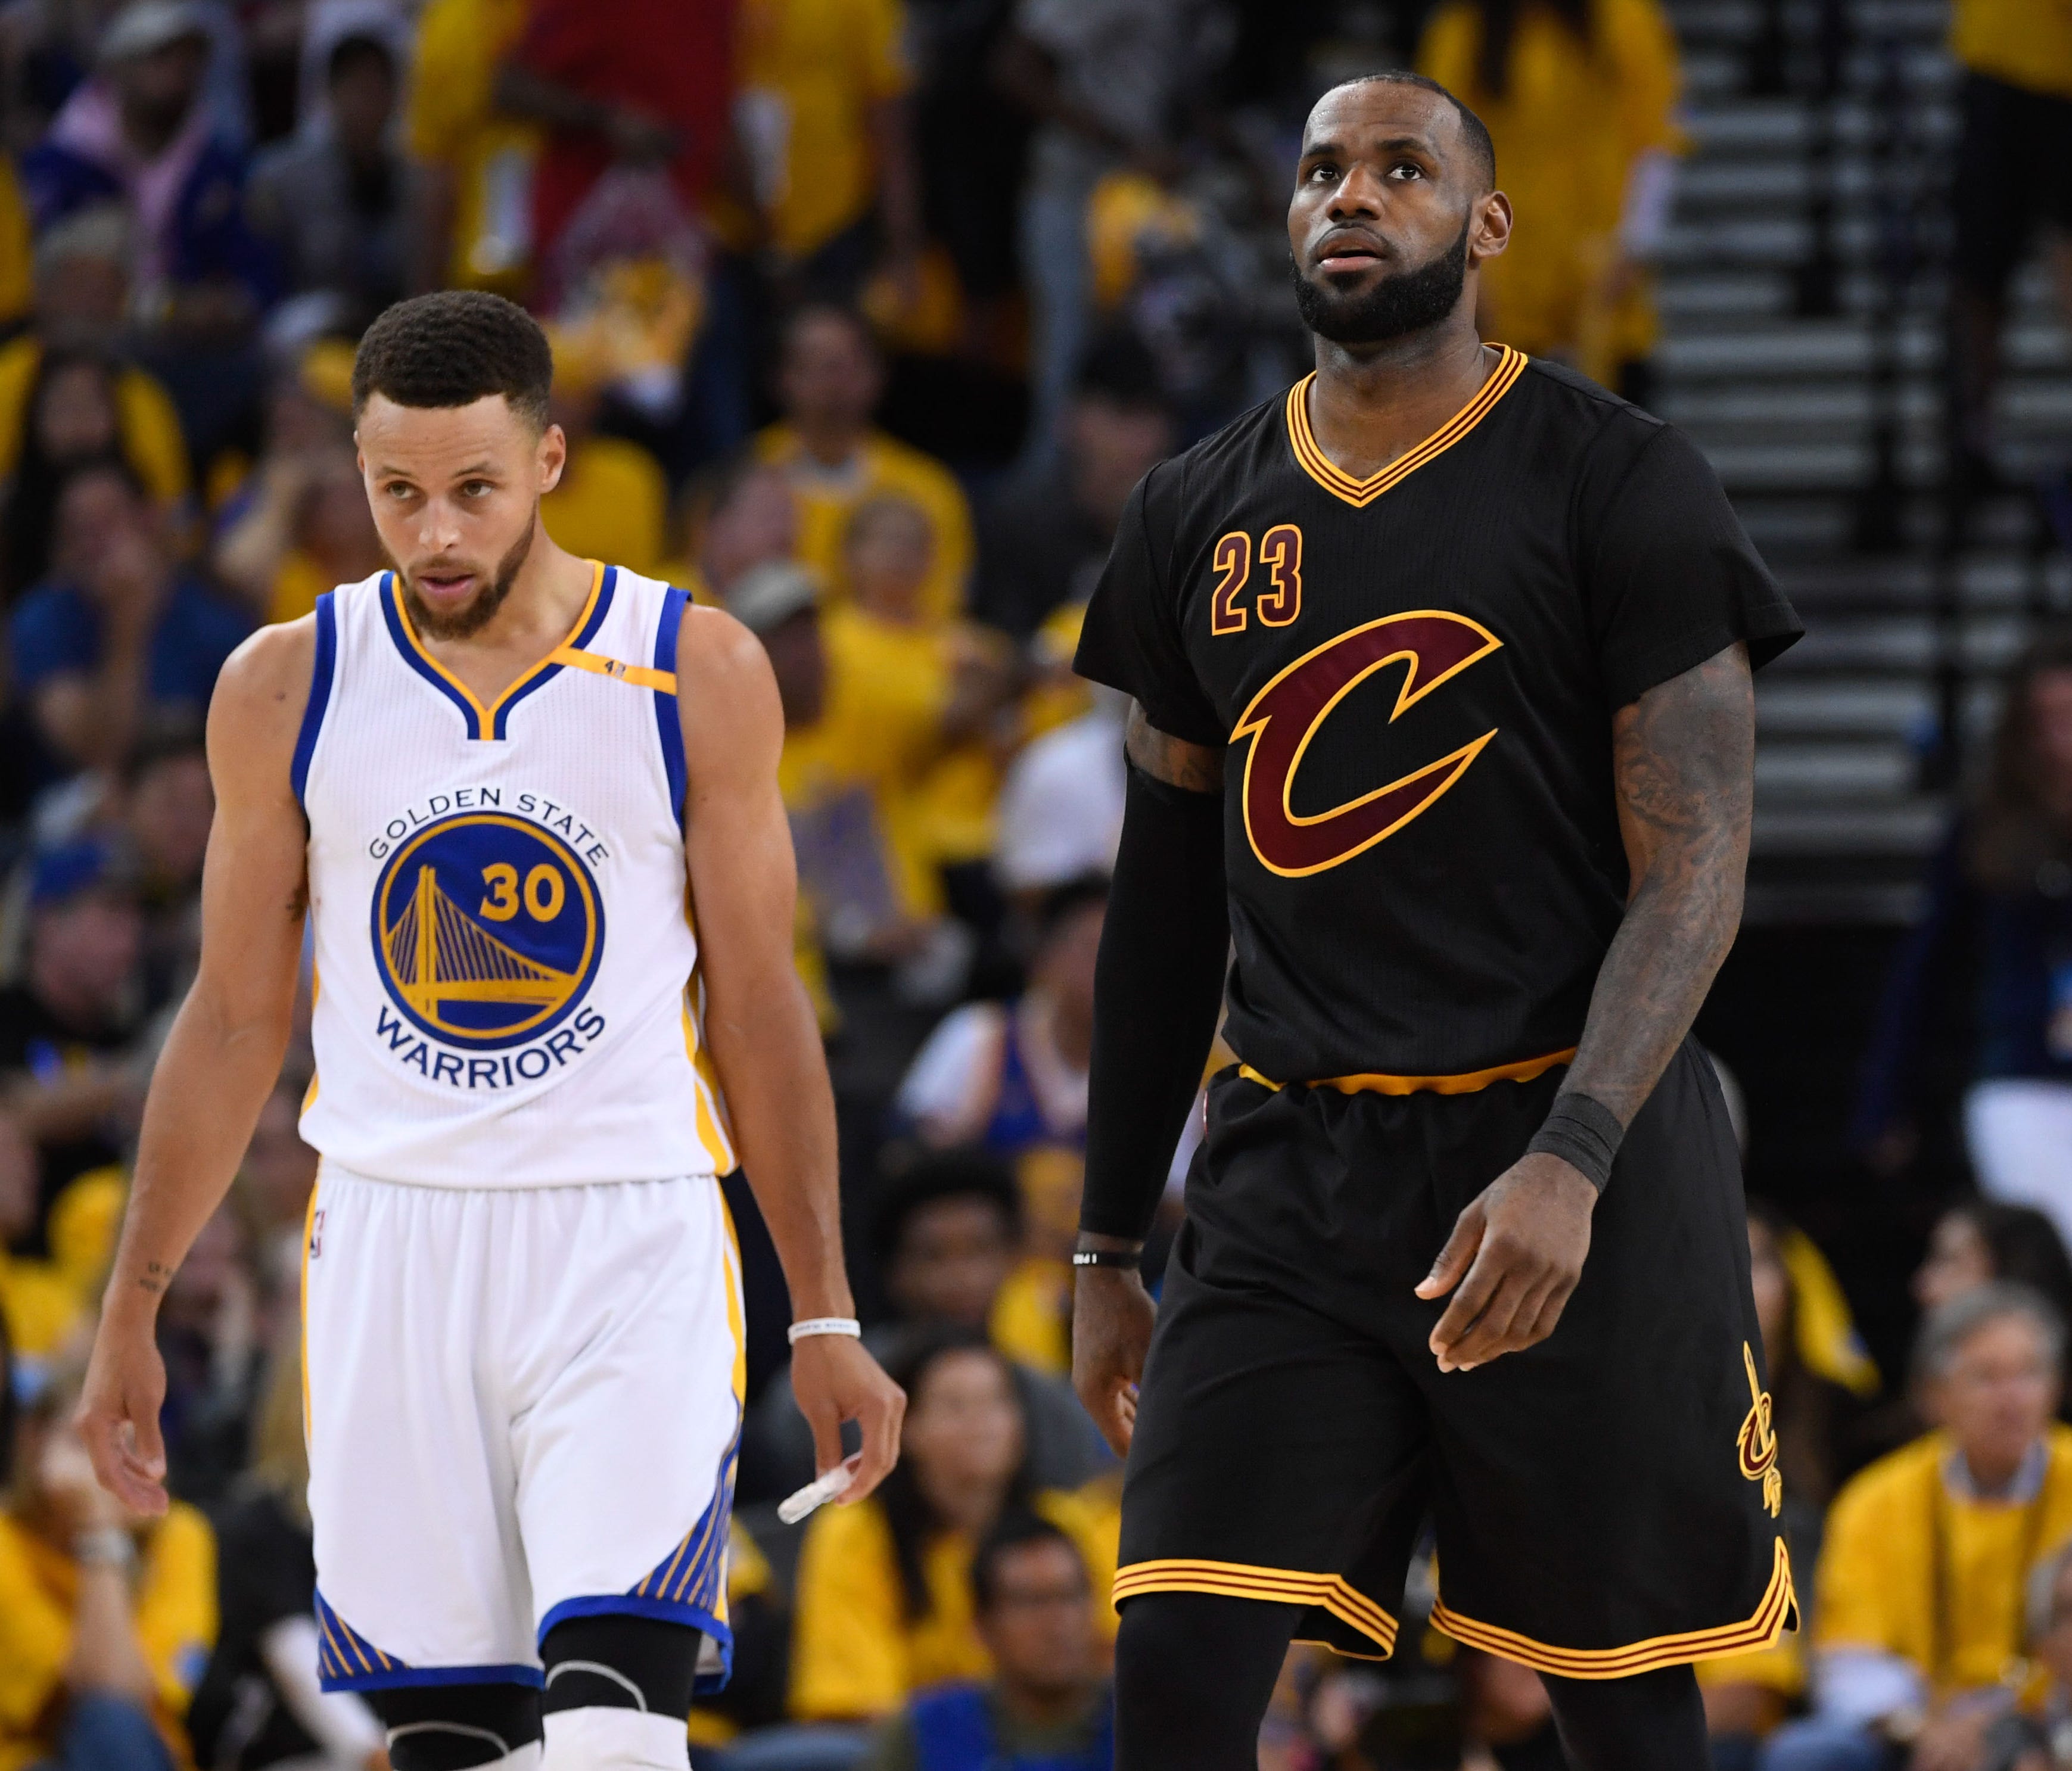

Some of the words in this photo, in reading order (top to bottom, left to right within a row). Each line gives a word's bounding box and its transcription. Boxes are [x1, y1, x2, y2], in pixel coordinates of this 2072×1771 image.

[1212, 524, 1302, 636] 23
[1228, 609, 1504, 878] C
[369, 788, 500, 861] GOLDEN
[517, 793, 609, 867] STATE
[478, 862, 565, 923] 30
[376, 1004, 605, 1089] WARRIORS
